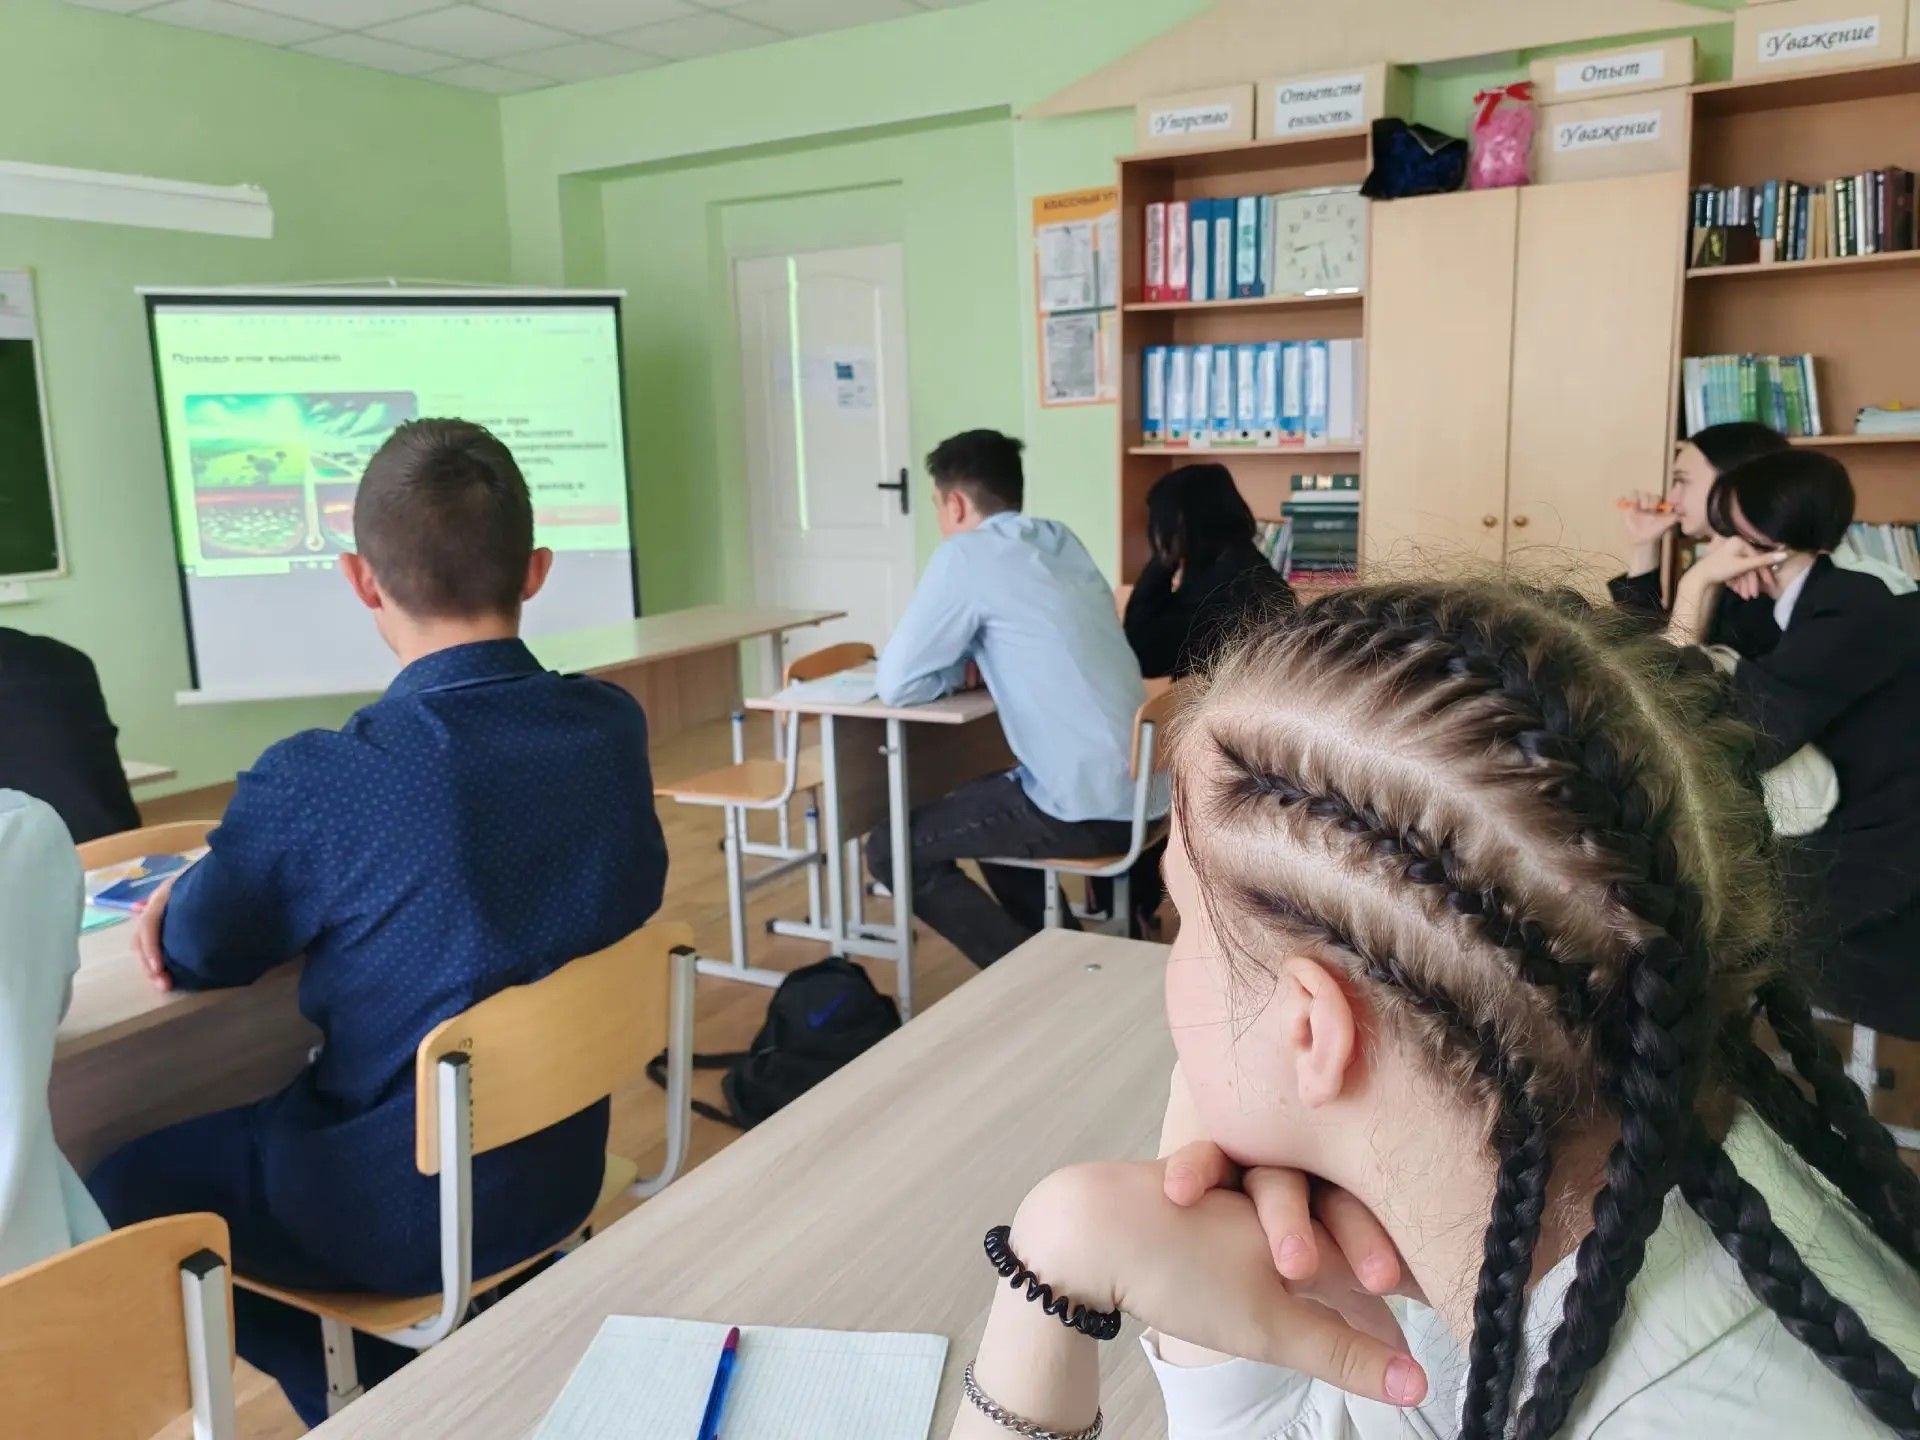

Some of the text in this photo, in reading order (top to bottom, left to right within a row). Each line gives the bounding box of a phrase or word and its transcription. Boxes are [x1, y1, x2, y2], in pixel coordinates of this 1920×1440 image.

[1766, 25, 1875, 57] Уважение
[1581, 62, 1640, 82] Опыт
[1155, 111, 1228, 133] Упорство
[1560, 120, 1656, 147] Уважение
